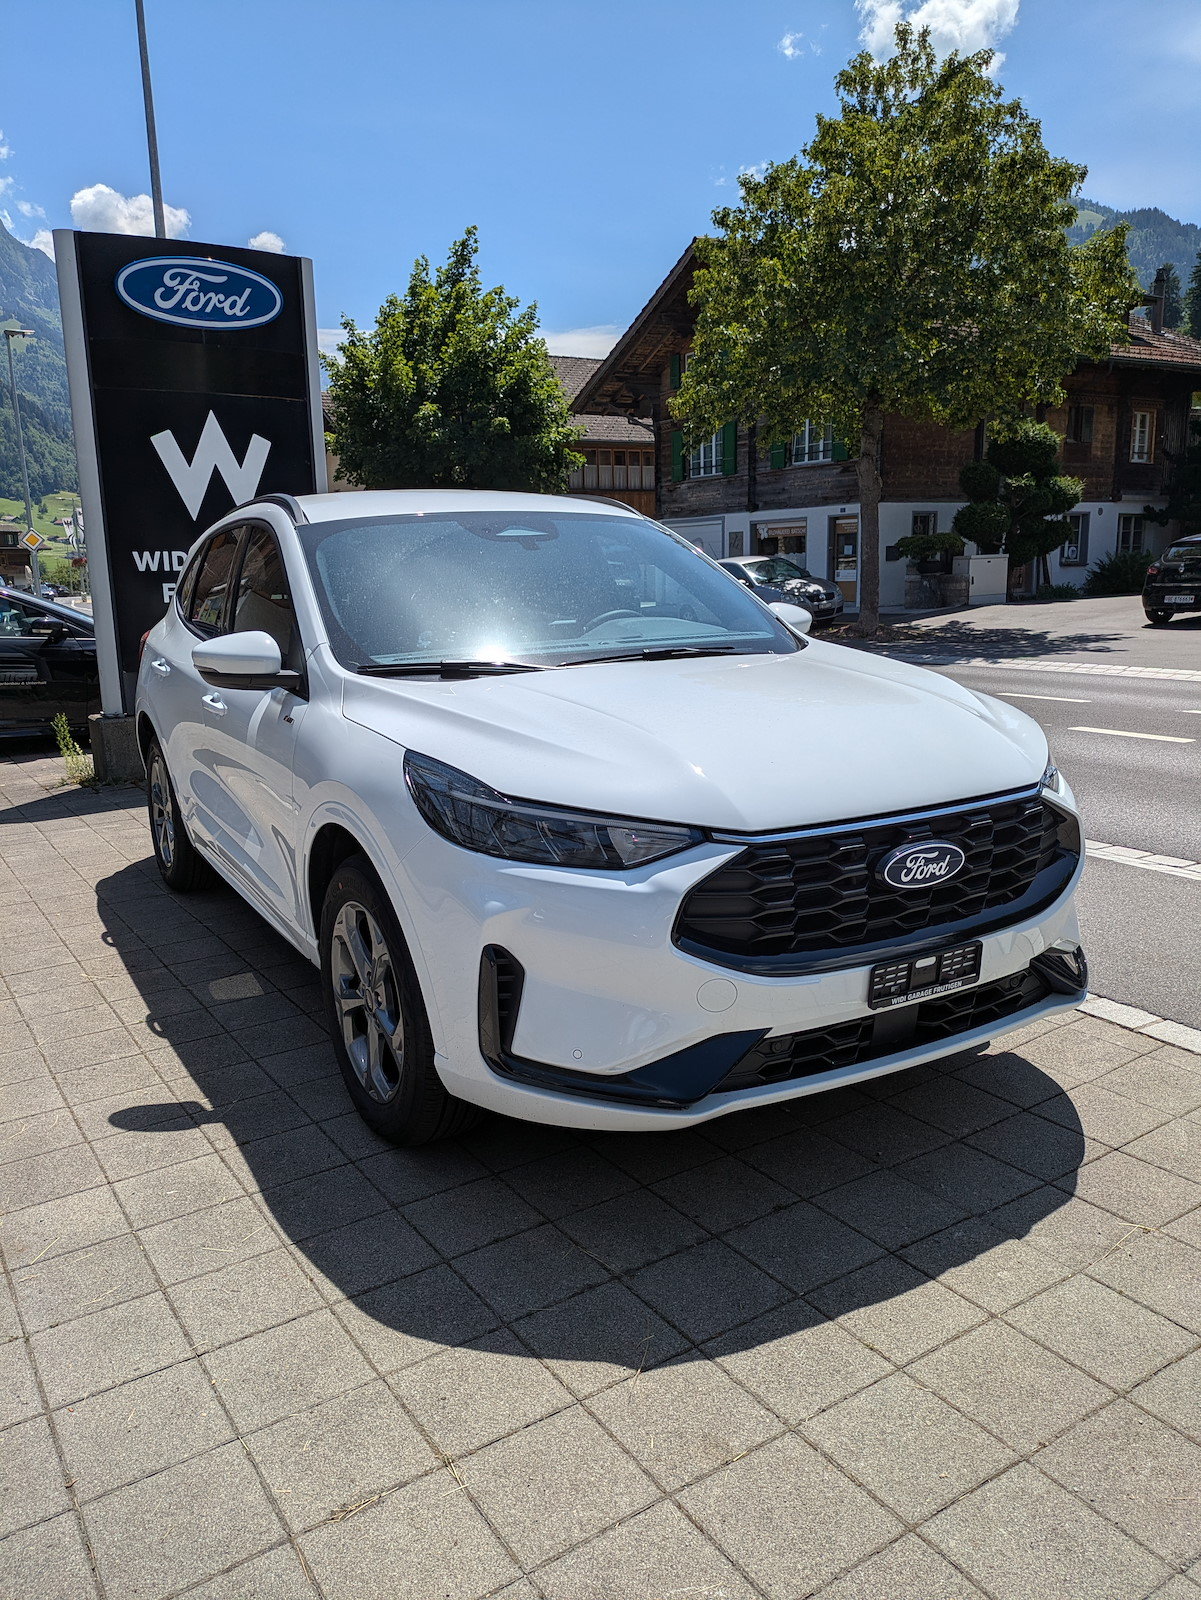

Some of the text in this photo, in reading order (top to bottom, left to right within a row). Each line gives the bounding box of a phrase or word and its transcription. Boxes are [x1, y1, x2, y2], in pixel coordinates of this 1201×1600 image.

[154, 268, 251, 317] Ford
[132, 550, 189, 572] WID
[900, 851, 951, 882] Ford
[891, 980, 963, 1005] WIDI GARAGE FRUTIGEN
